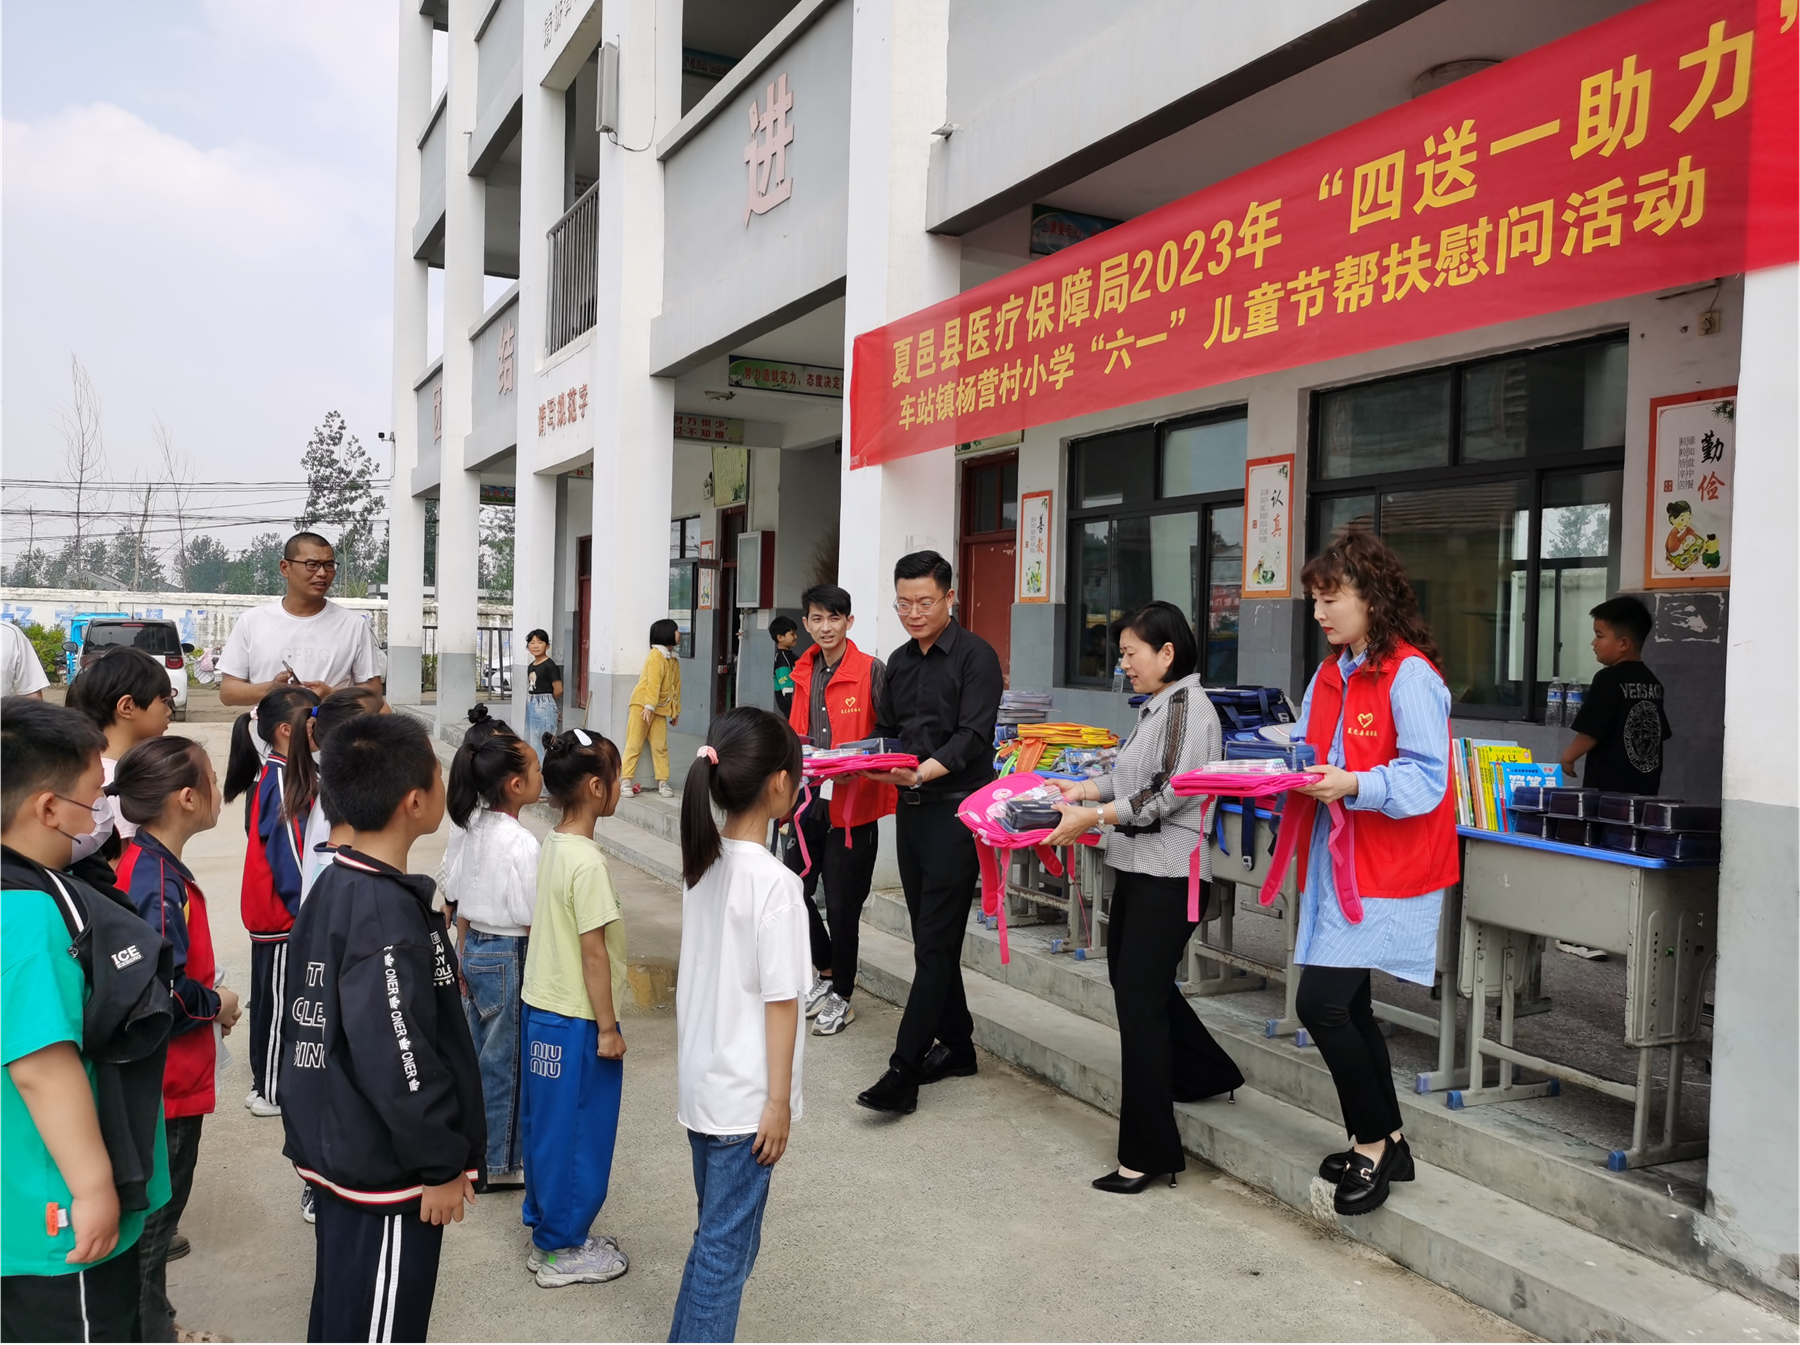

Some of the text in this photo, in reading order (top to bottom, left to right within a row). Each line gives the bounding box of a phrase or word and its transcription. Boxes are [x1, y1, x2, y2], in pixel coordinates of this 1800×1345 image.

[743, 72, 795, 229] 进
[744, 366, 844, 391] 努力造就实力，态度决定
[538, 383, 588, 437] 请写规范字
[111, 945, 139, 965] ICE
[385, 968, 399, 996] ONER
[391, 1010, 408, 1038] ONER
[401, 1051, 418, 1079] ONER
